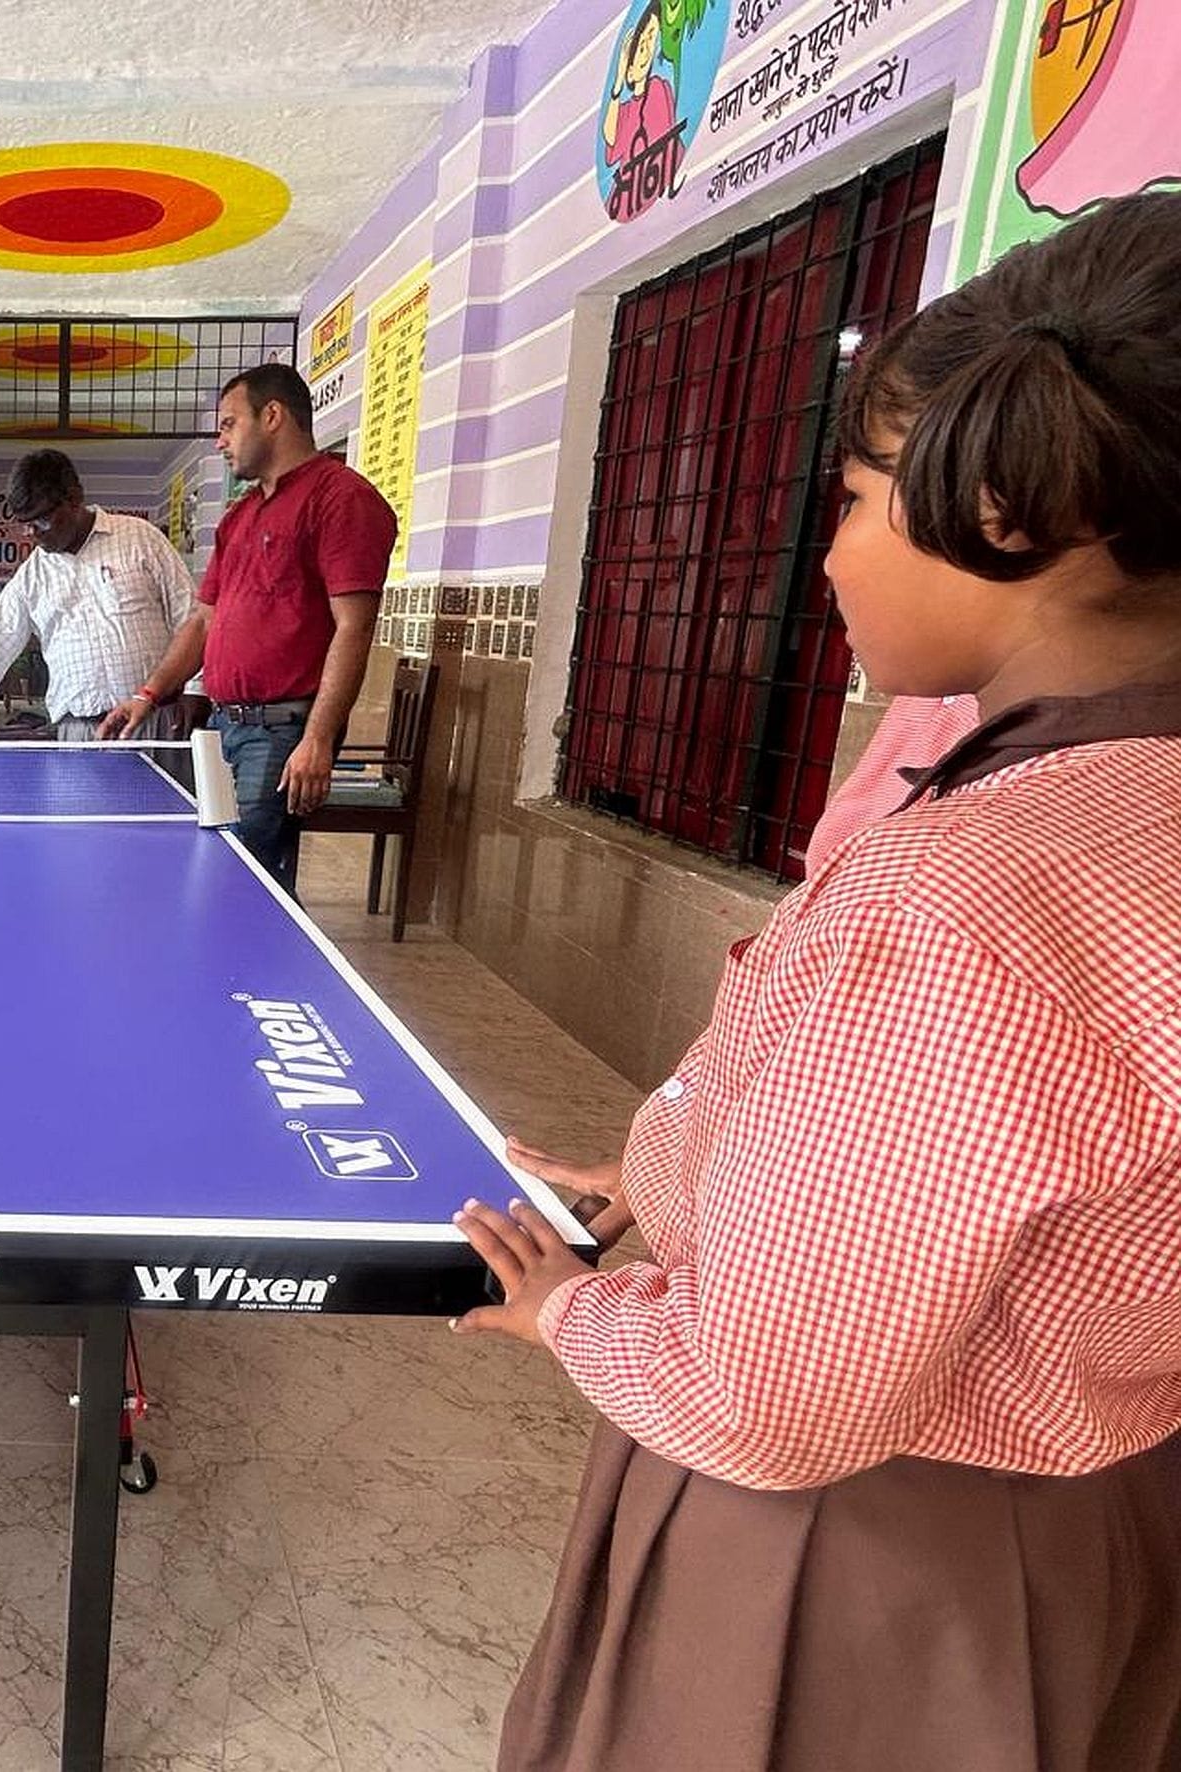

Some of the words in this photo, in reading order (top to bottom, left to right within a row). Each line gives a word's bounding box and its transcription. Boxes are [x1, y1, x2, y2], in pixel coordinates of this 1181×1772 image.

[709, 79, 749, 134] खाना
[749, 48, 787, 106] खाने
[784, 34, 808, 79] से
[807, 0, 852, 63] पहले
[775, 123, 803, 164] का
[799, 89, 861, 153] प्रयोग
[247, 999, 365, 1109] Vixen
[194, 1267, 328, 1303] Vixen
